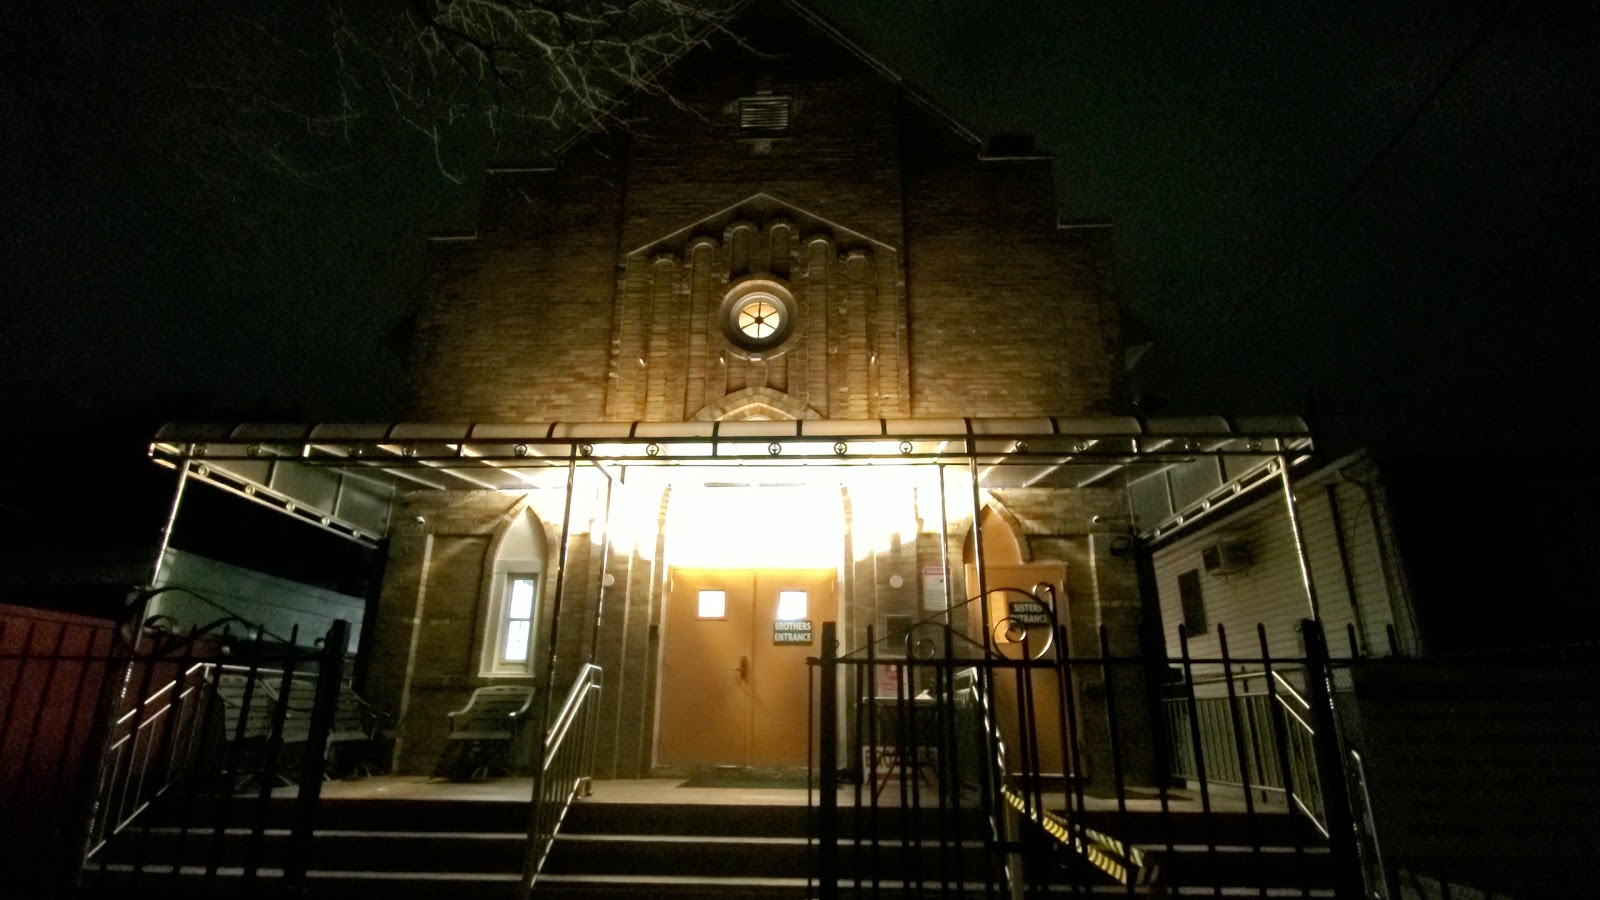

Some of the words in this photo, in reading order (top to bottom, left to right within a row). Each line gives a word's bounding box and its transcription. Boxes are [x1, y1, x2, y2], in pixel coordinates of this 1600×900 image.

[1013, 603, 1043, 612] SISTERS
[774, 622, 811, 631] BROTHERS
[774, 632, 811, 641] ENTRANCE
